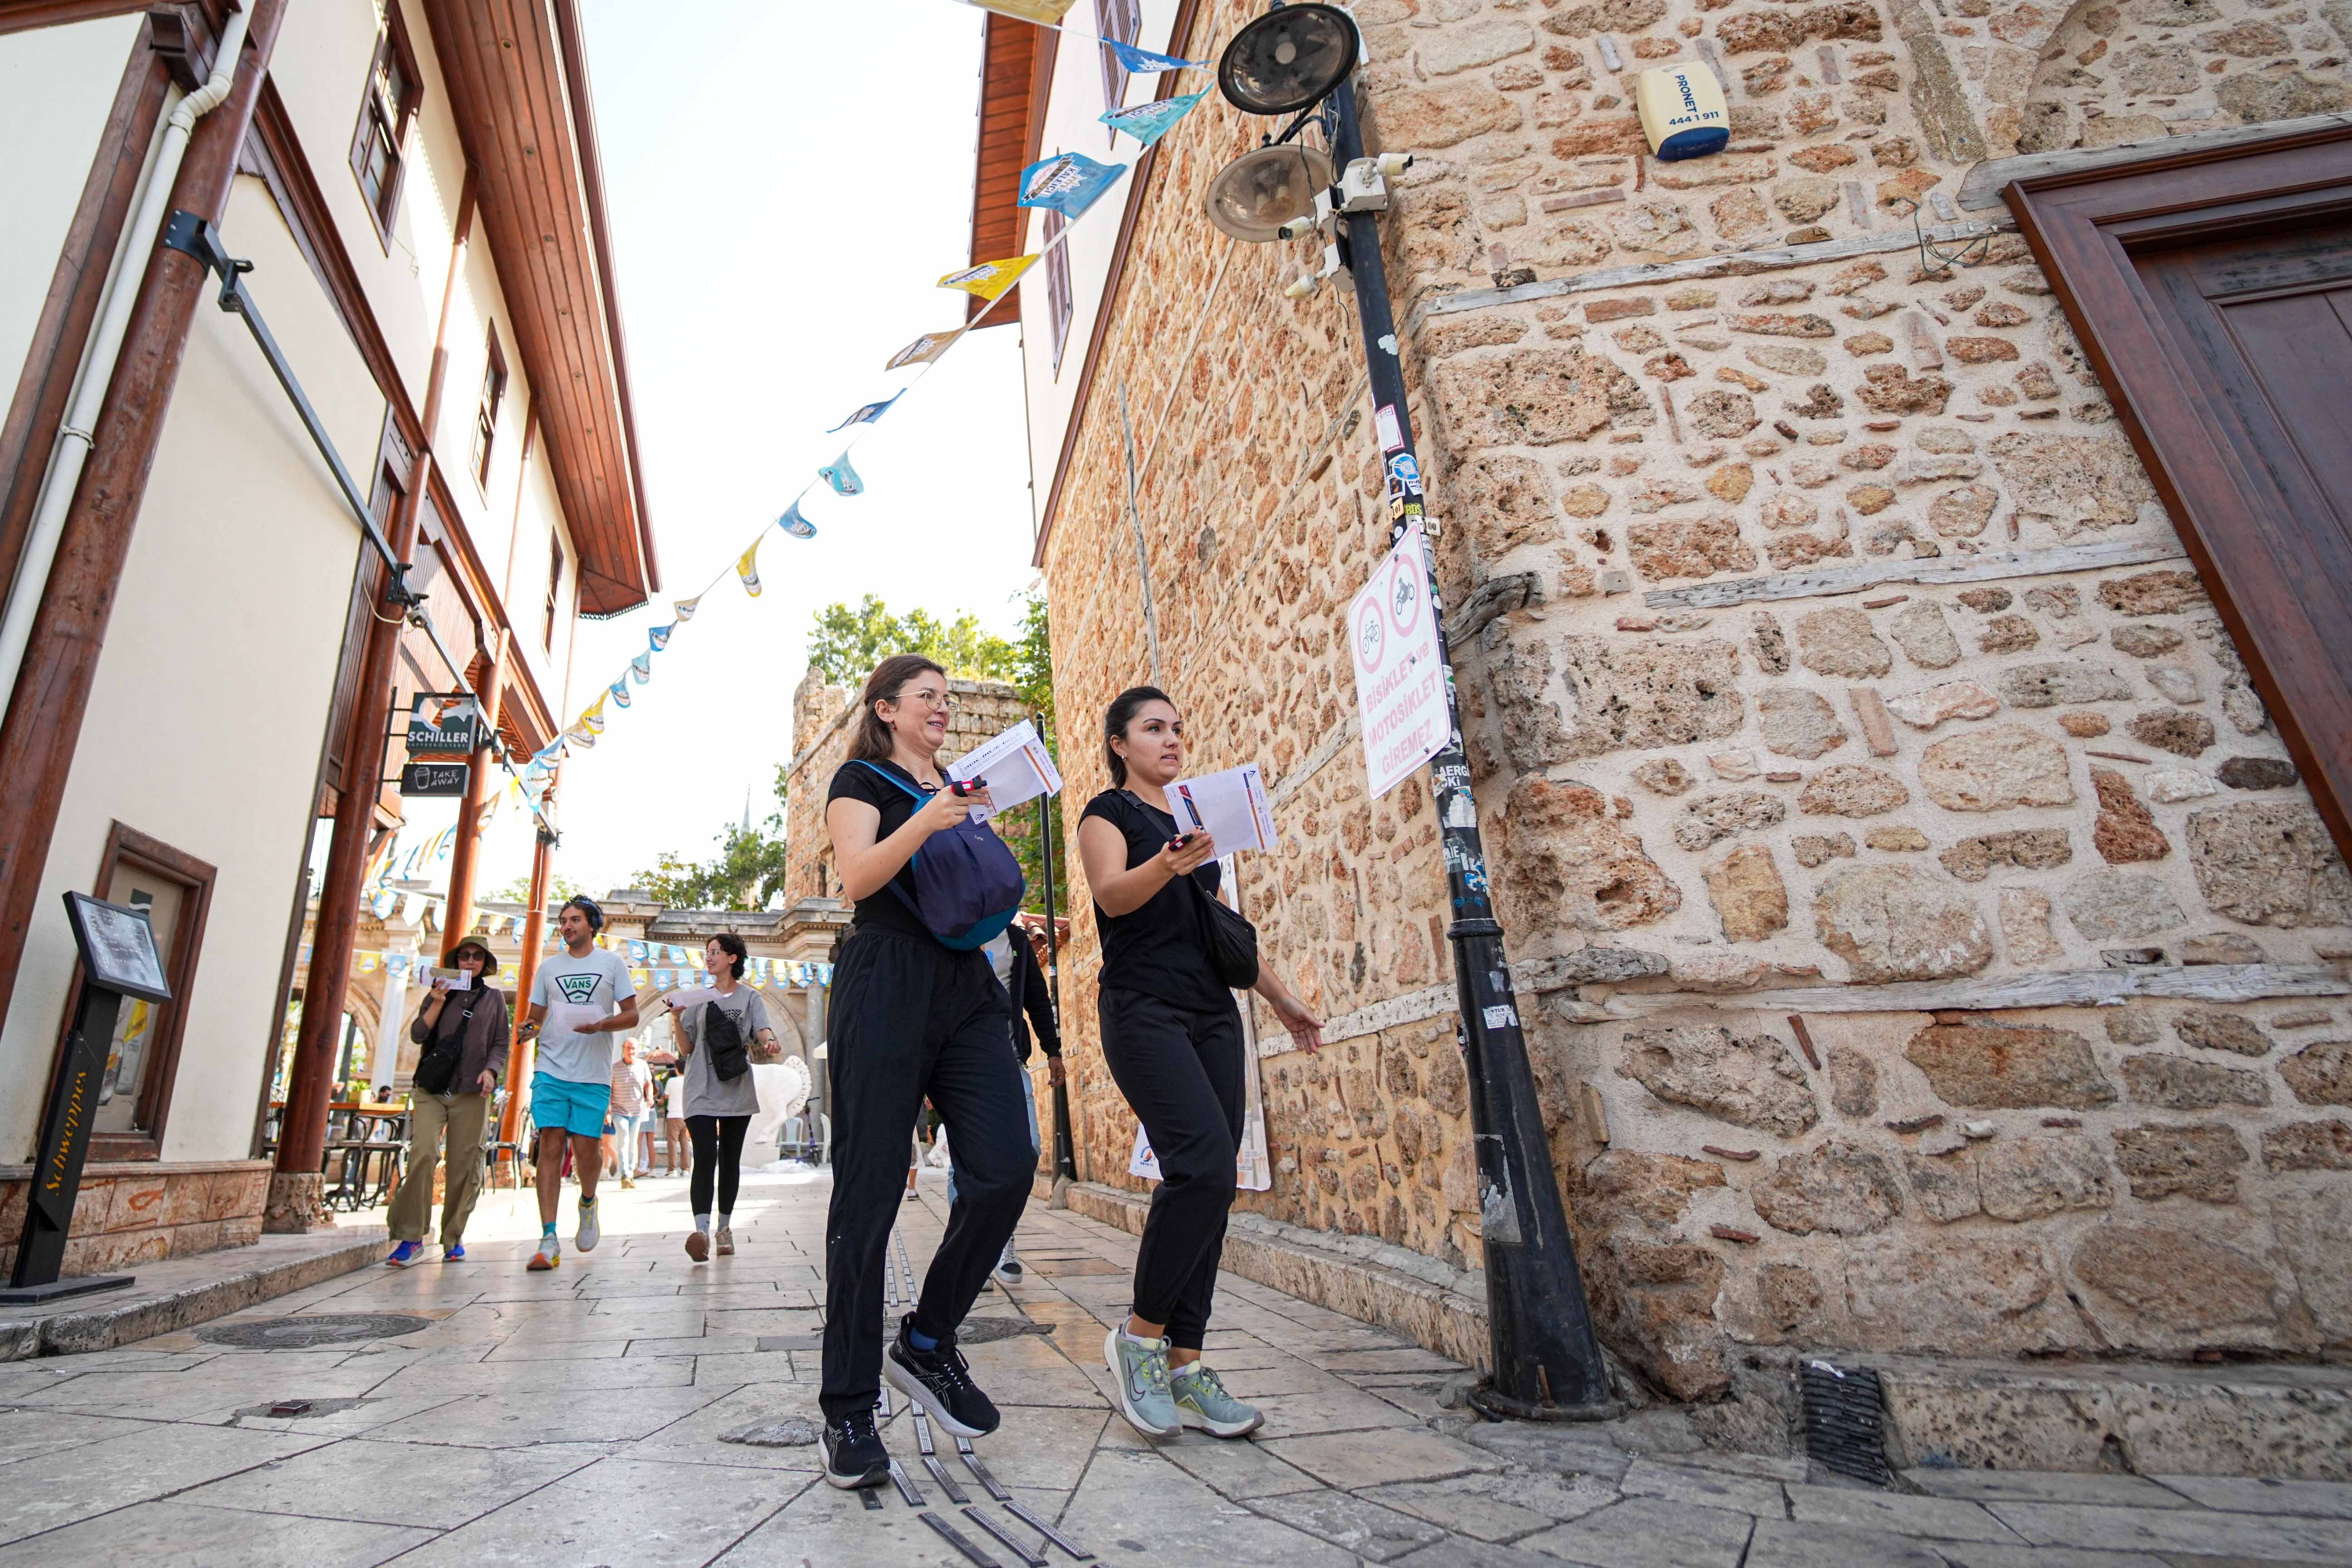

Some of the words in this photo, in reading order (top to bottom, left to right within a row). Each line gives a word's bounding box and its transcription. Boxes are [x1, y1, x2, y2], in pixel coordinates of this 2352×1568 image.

[1675, 74, 1697, 112] PRONET
[1669, 116, 1692, 125] 444
[1702, 111, 1719, 119] 911
[1415, 641, 1429, 664] ve
[1368, 669, 1437, 748] MOTOSİKLET
[408, 731, 469, 743] SCHILLER
[1382, 718, 1434, 775] GİREMEZ
[430, 777, 460, 786] AWAY
[432, 769, 458, 778] TAKE
[564, 977, 591, 989] VANS
[46, 1071, 87, 1197] Schweppes
